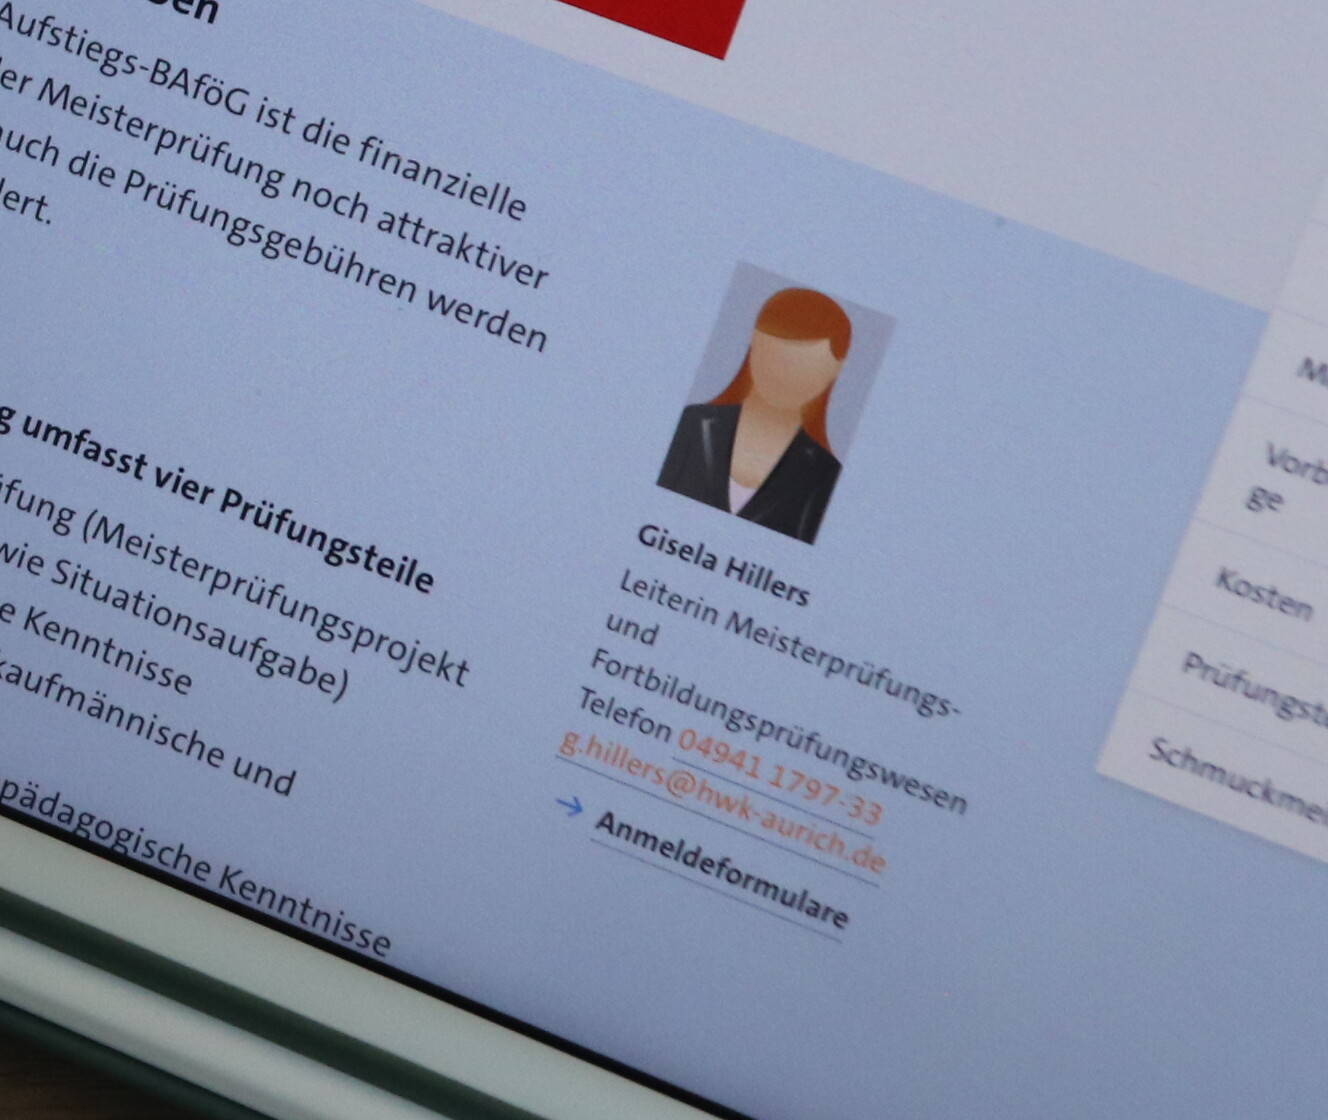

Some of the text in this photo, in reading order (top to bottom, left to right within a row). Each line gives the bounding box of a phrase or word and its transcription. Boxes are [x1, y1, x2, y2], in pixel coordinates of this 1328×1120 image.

[36, 76, 285, 199] Meisterprüfung
[290, 177, 369, 223] noch
[376, 210, 549, 288] attraktiver
[255, 96, 295, 135] ist
[301, 116, 350, 155] die
[358, 134, 526, 221] finanzielle
[67, 149, 116, 188] die
[122, 168, 417, 303] Prüfungsgebühren
[427, 289, 547, 352] werden
[21, 414, 148, 481] umfasst
[154, 466, 215, 505] vier
[219, 487, 434, 594] Prüfungsteile
[1245, 486, 1285, 513] ge
[81, 508, 469, 687] (Meisterprüfungsprojekt
[637, 523, 809, 607] Gisela Hillers
[1215, 566, 1314, 622] Kosten
[22, 605, 192, 695] Kenntnisse
[50, 558, 348, 703] Situationsaufgabe)
[605, 613, 660, 646] und
[619, 568, 959, 718] Leiterin Meisterprüfungs-
[1182, 650, 1328, 728] Prüfungst
[232, 756, 297, 797] und
[580, 685, 885, 827] Telefon 04941 1797-33
[590, 647, 967, 814] Fortbildungsprüfungswesen
[1148, 737, 1328, 828] Schmuckme
[559, 731, 886, 873] g.hillers@hwk-aurich.de
[217, 862, 394, 960] Kenntnisse
[595, 810, 849, 929] Anmeldeformulare
